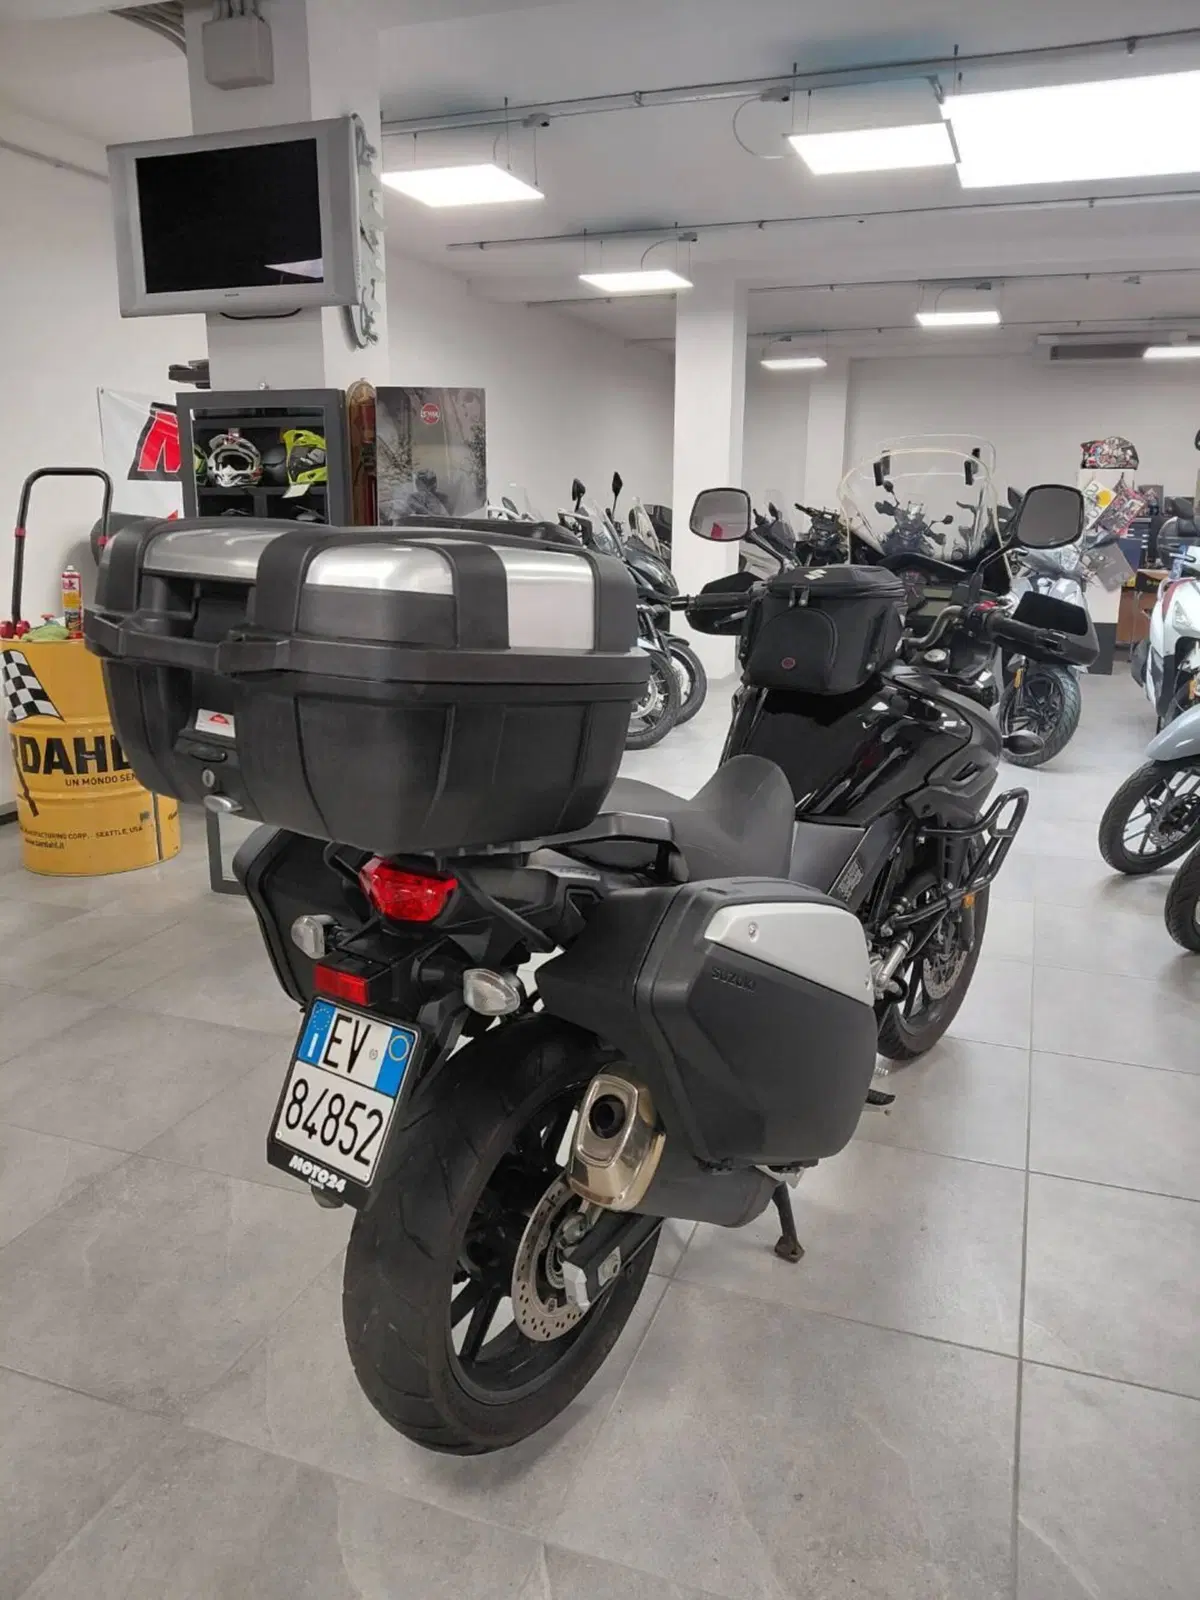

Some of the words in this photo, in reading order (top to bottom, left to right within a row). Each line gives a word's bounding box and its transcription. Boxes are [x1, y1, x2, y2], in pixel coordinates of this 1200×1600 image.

[65, 778, 80, 787] UN
[82, 776, 118, 786] MONDO
[322, 1013, 372, 1074] EV
[285, 1078, 384, 1167] 84852
[288, 1154, 348, 1193] MOTO24
